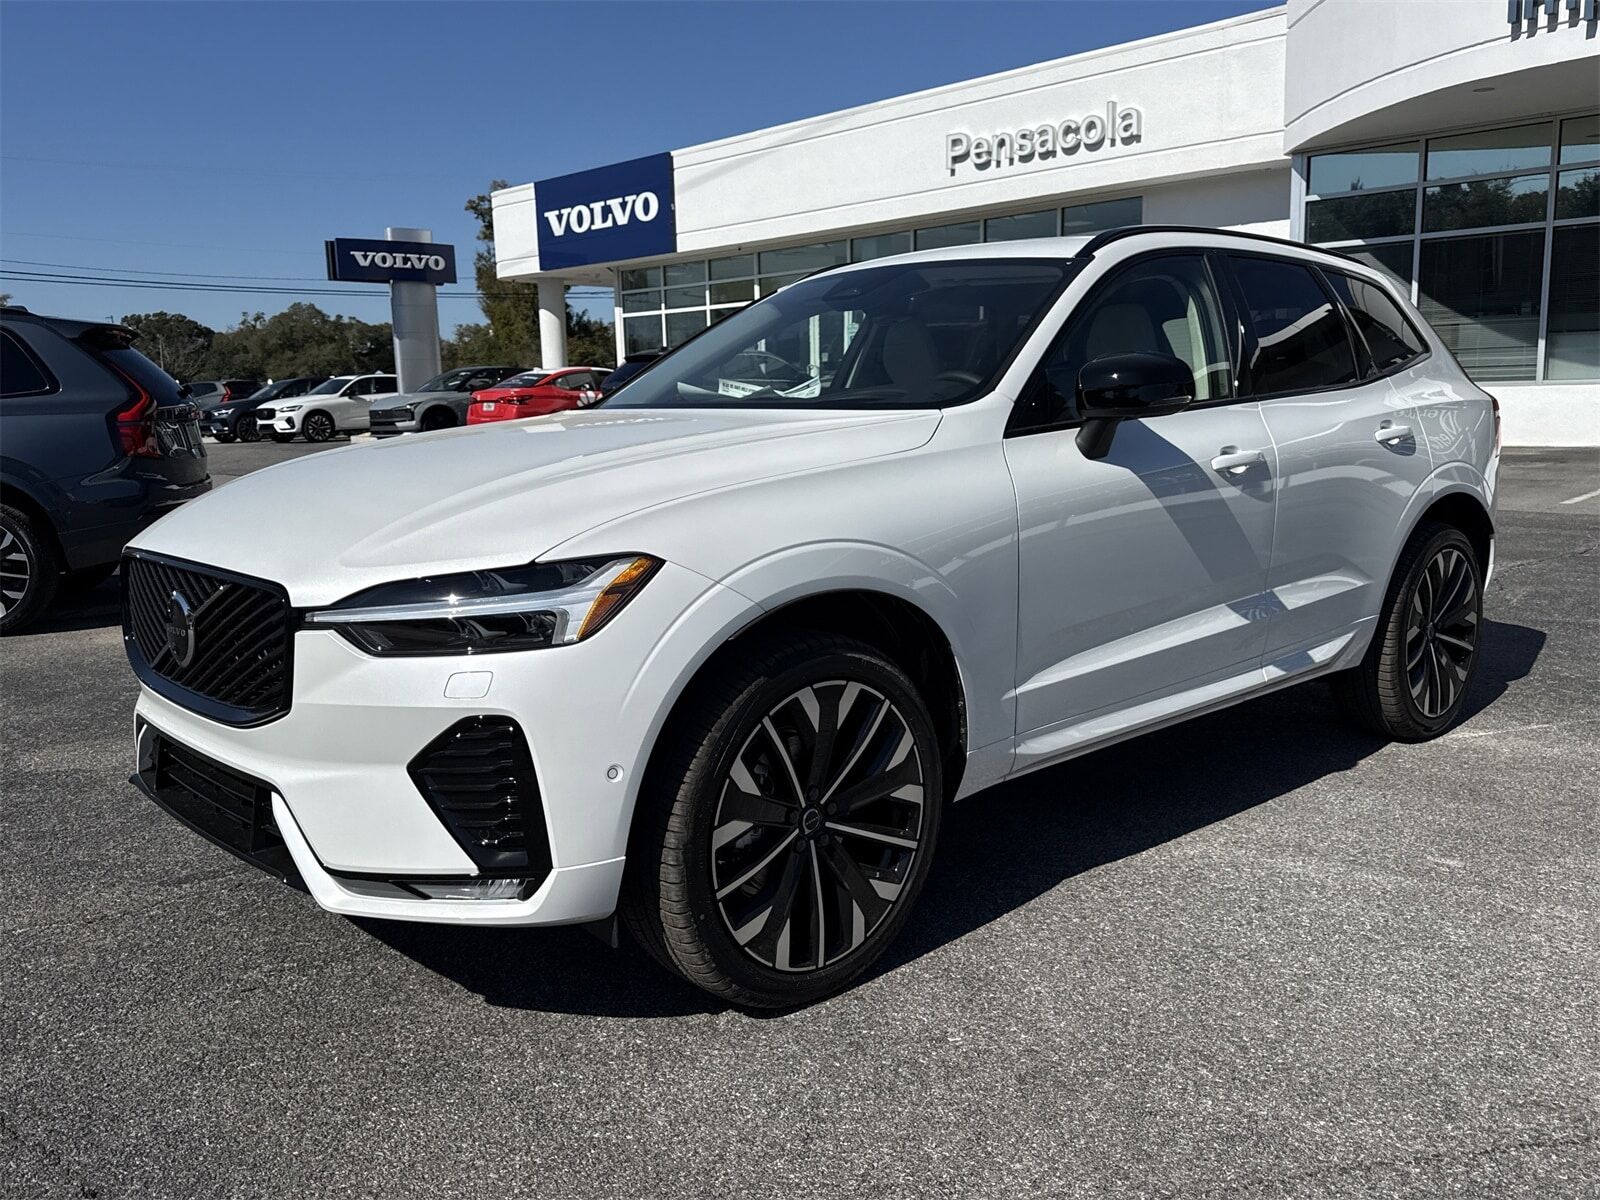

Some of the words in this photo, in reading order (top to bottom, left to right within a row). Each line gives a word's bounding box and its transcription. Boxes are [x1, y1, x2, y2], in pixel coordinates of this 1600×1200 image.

[945, 100, 1142, 171] Pensacola
[543, 191, 659, 237] VOLVO
[350, 251, 446, 271] VOLVO
